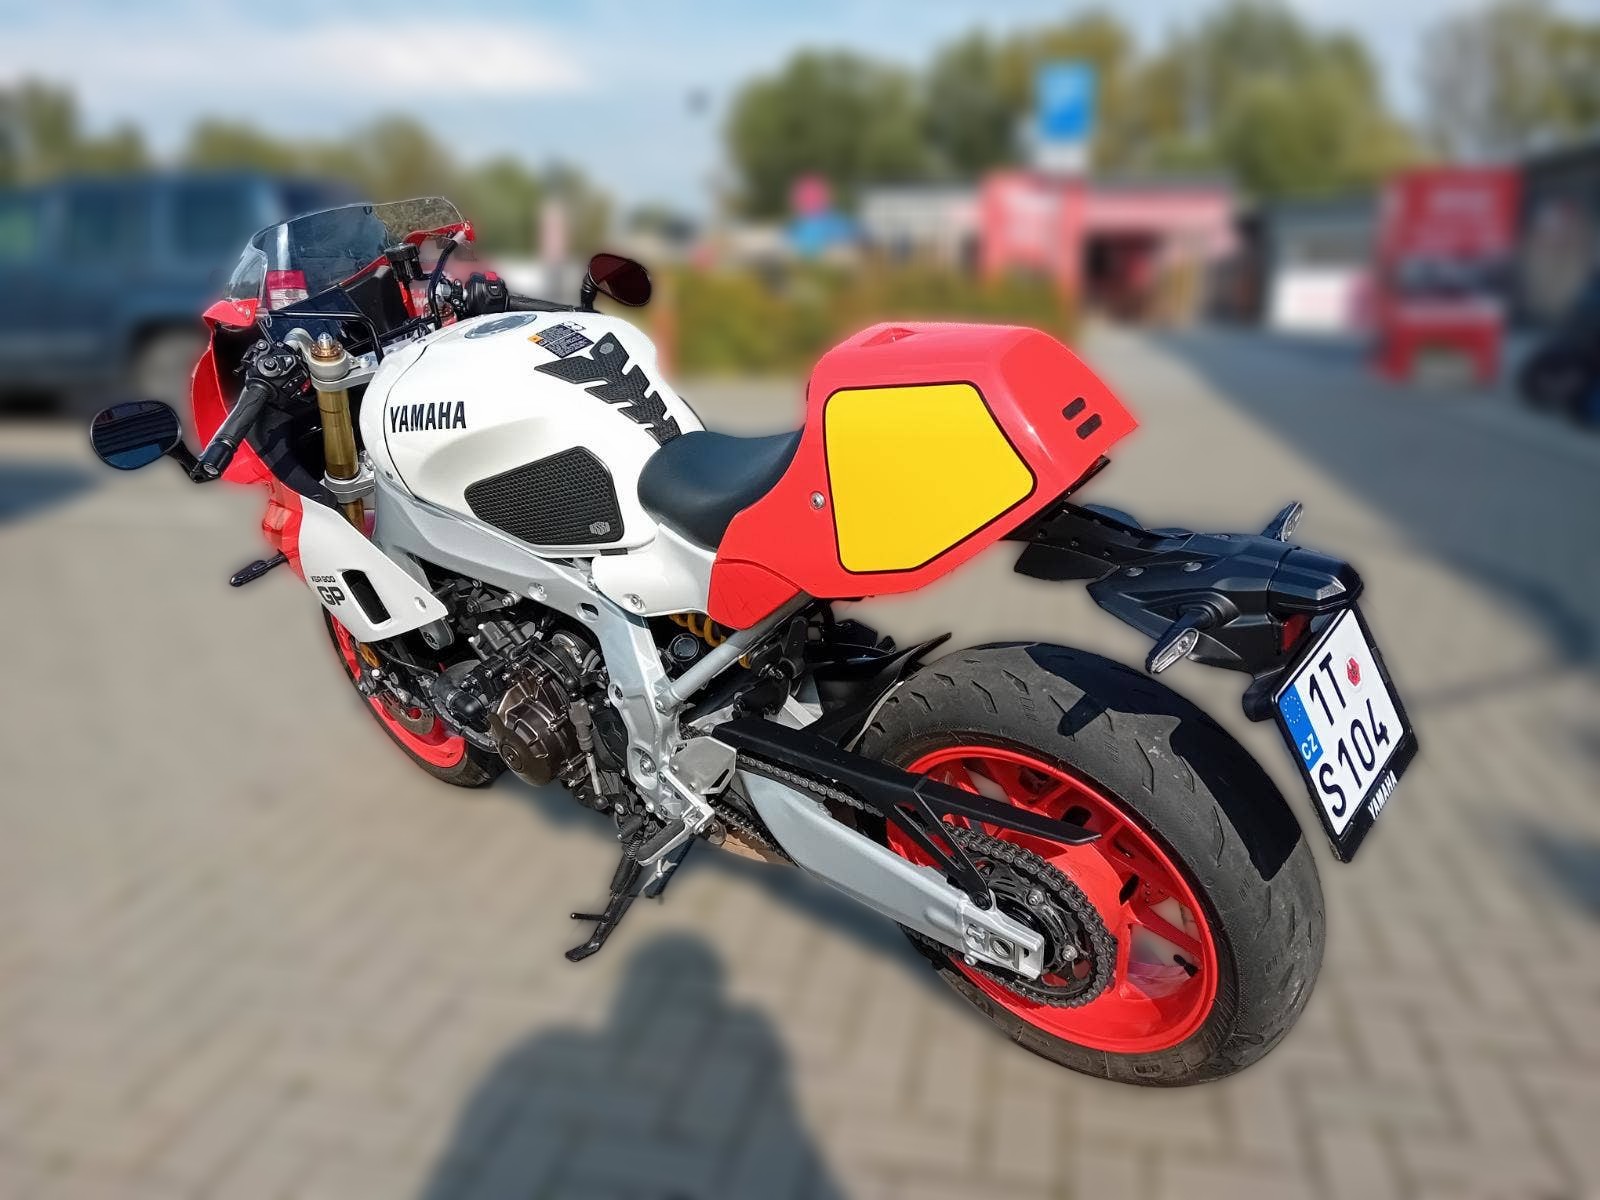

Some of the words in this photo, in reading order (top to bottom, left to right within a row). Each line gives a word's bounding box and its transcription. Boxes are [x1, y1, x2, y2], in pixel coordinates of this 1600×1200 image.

[390, 401, 467, 433] YAMAHA
[317, 586, 345, 606] GP
[1309, 652, 1347, 726] 1T
[1301, 735, 1318, 761] CZ
[1319, 699, 1390, 818] S104
[1367, 770, 1398, 821] YAMAHA
